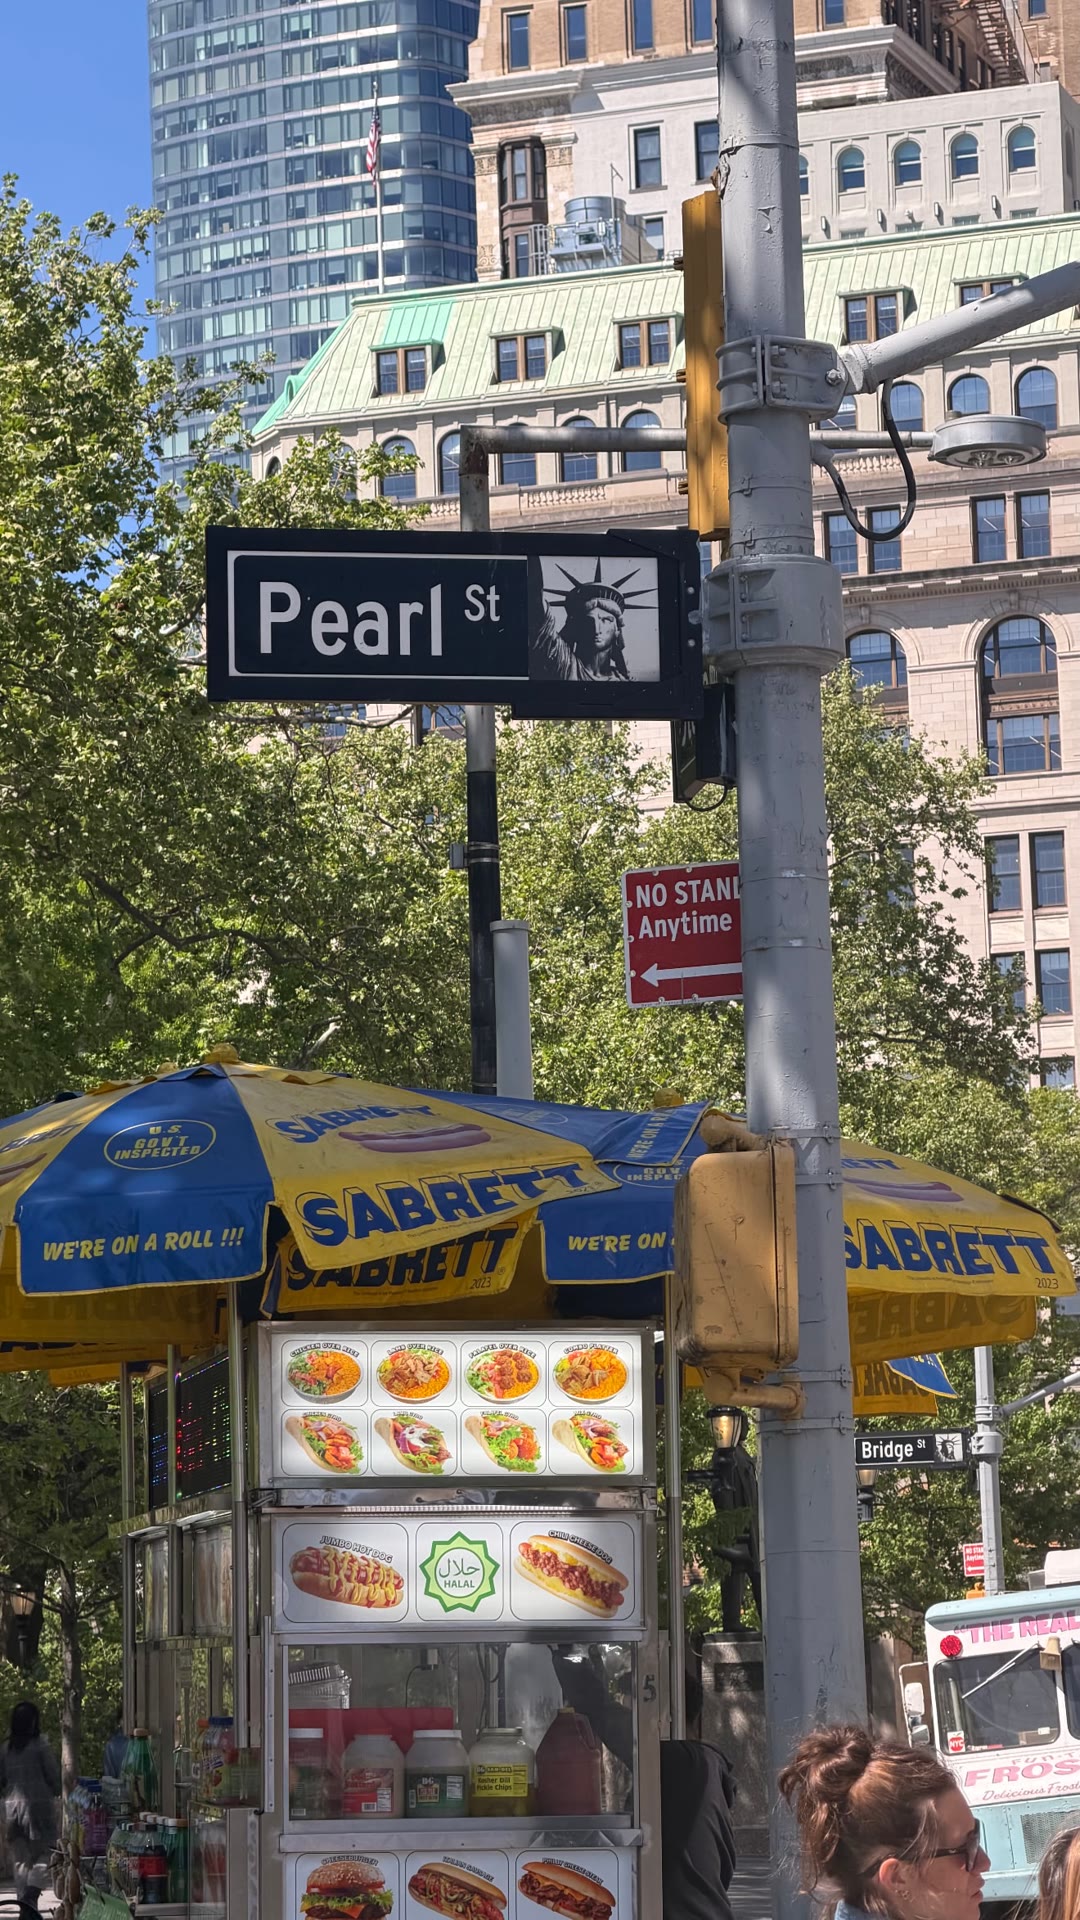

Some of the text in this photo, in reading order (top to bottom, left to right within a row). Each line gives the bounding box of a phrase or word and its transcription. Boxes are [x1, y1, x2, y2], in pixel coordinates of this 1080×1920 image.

[259, 581, 501, 656] Pearl St
[636, 883, 668, 909] NO
[638, 910, 732, 942] Anytime
[149, 1125, 181, 1135] U.S.
[267, 1104, 440, 1144] SABRETT
[114, 1145, 201, 1160] INSPECTED
[296, 1160, 586, 1247] SABRETT
[43, 1227, 244, 1261] WE'RE ON A ROLL !!!
[568, 1232, 666, 1252] WE'RE ON
[469, 1277, 492, 1290] 2023
[1035, 1277, 1059, 1289] 2023
[861, 1439, 926, 1462] Bridge St
[320, 1535, 393, 1564] JUMBO HOT DOG
[548, 1530, 613, 1565] CHILI CHEESE DOG
[438, 1557, 480, 1578] حلال
[443, 1580, 475, 1588] HALAL
[1018, 1610, 1080, 1638] REAL
[643, 1674, 657, 1702] 5
[964, 1758, 1080, 1787] FROS
[982, 1787, 1047, 1801] Delicious
[321, 1855, 379, 1866] CHEESEBURGER
